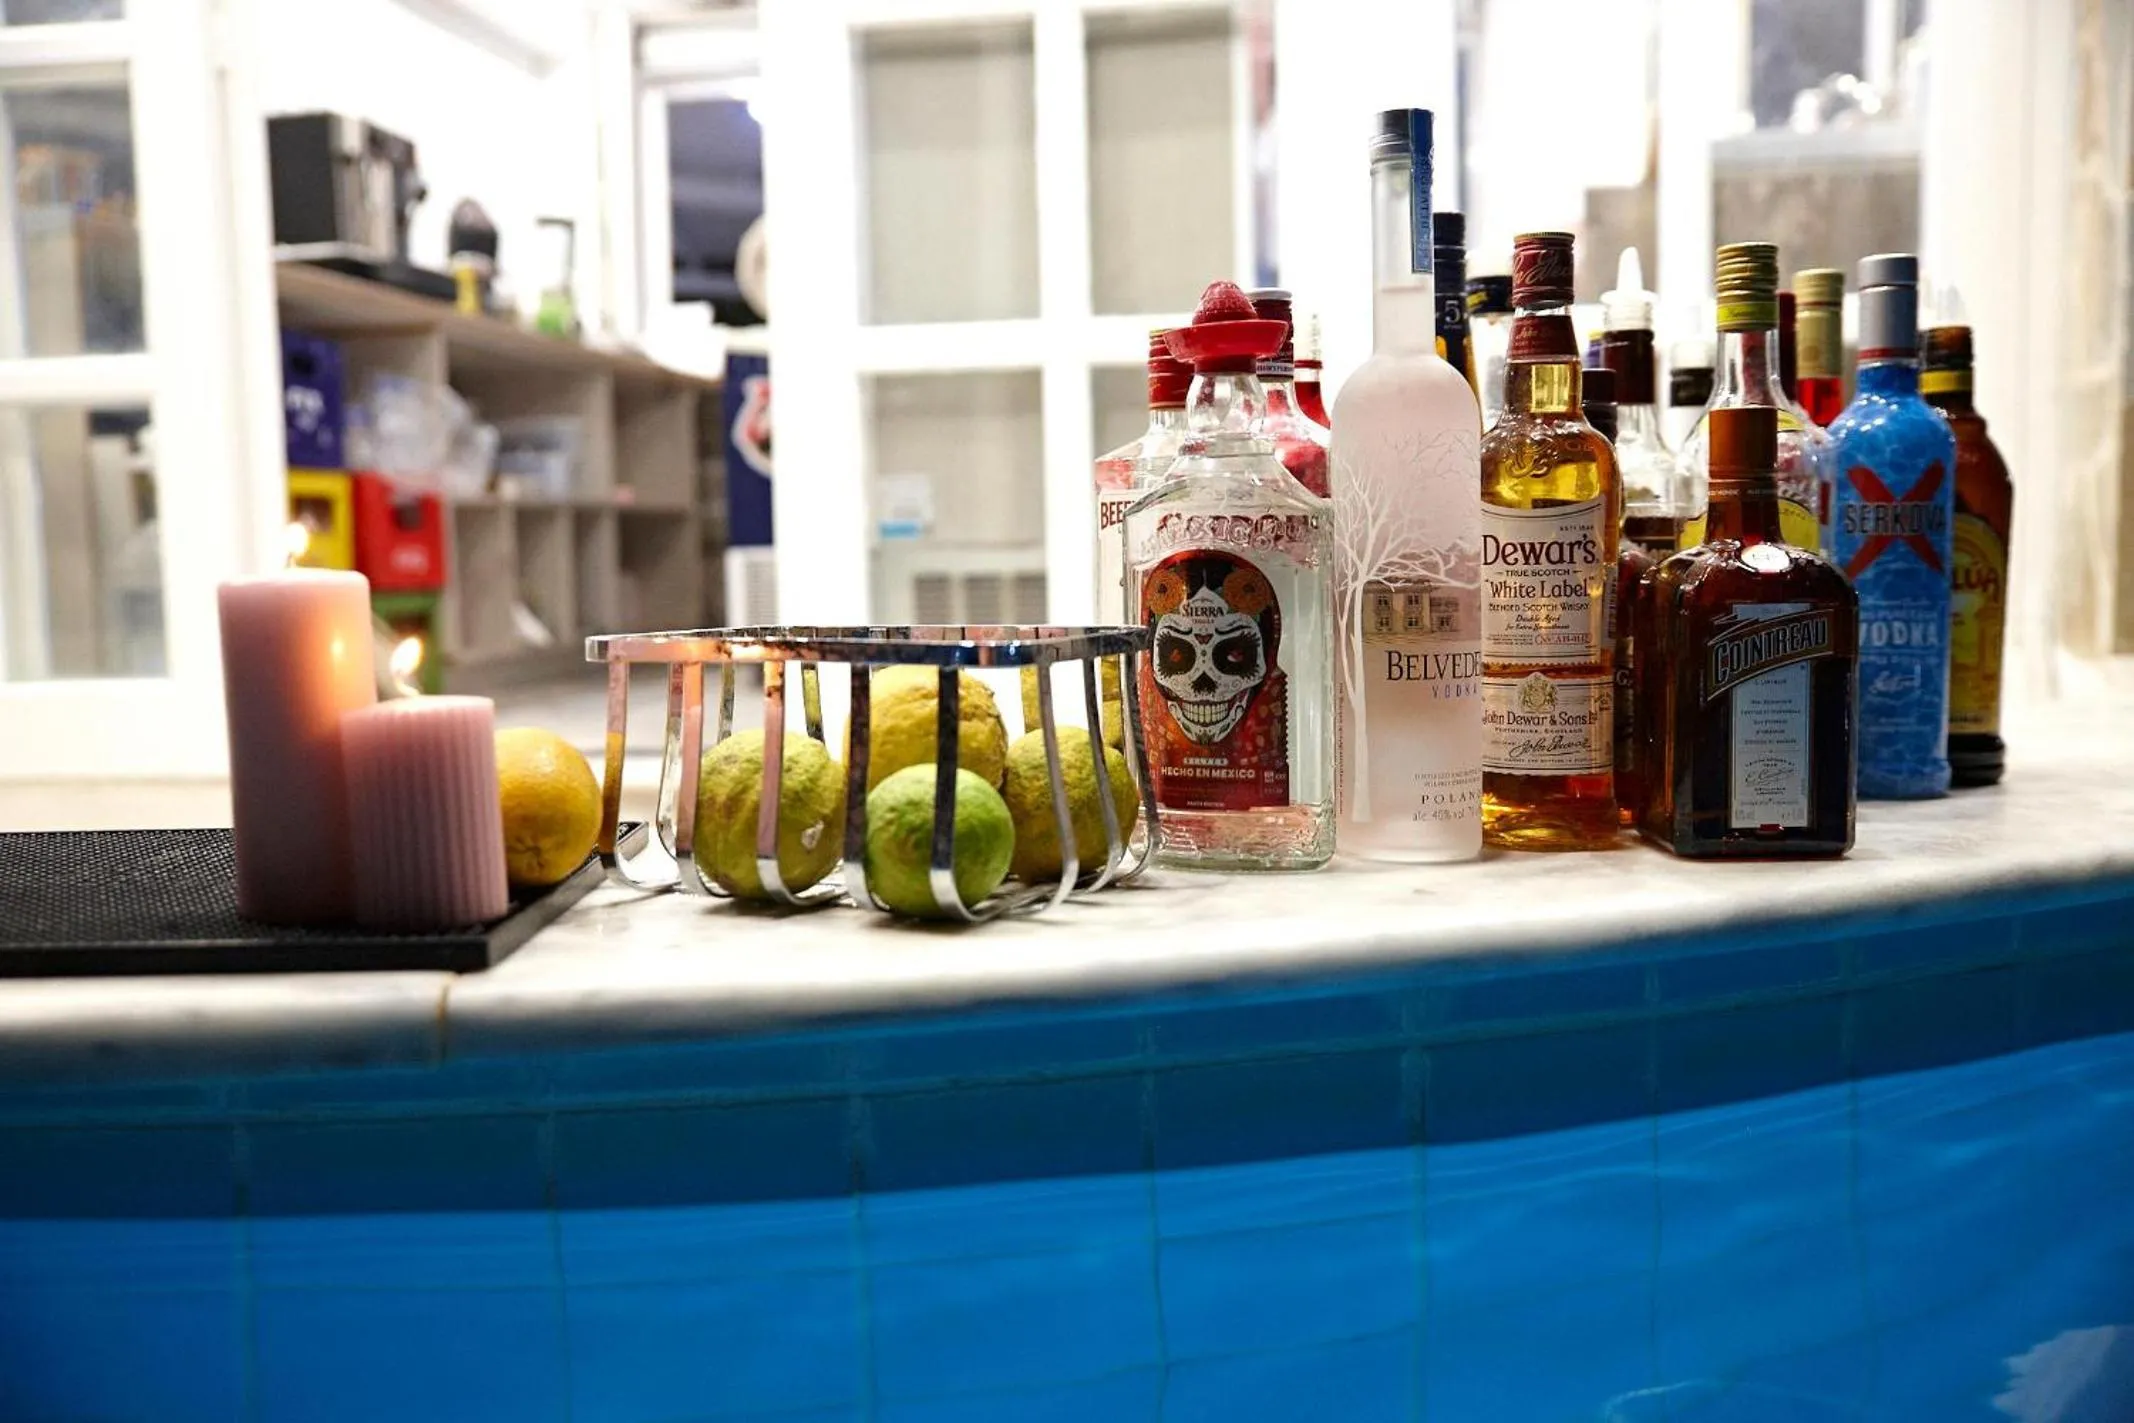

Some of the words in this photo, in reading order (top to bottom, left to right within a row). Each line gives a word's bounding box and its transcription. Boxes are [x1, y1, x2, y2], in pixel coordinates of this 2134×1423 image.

[1844, 502, 1945, 535] SERKOVA
[1531, 568, 1570, 577] SCOTCH
[1182, 602, 1225, 618] SIERRA
[1713, 618, 1828, 686] COINTREAU
[1507, 711, 1547, 725] Dewar
[1549, 712, 1557, 725] &
[1559, 711, 1587, 725] Sons
[1161, 767, 1194, 777] HECHO
[1196, 768, 1210, 778] EN
[1211, 769, 1256, 779] MEXICO
